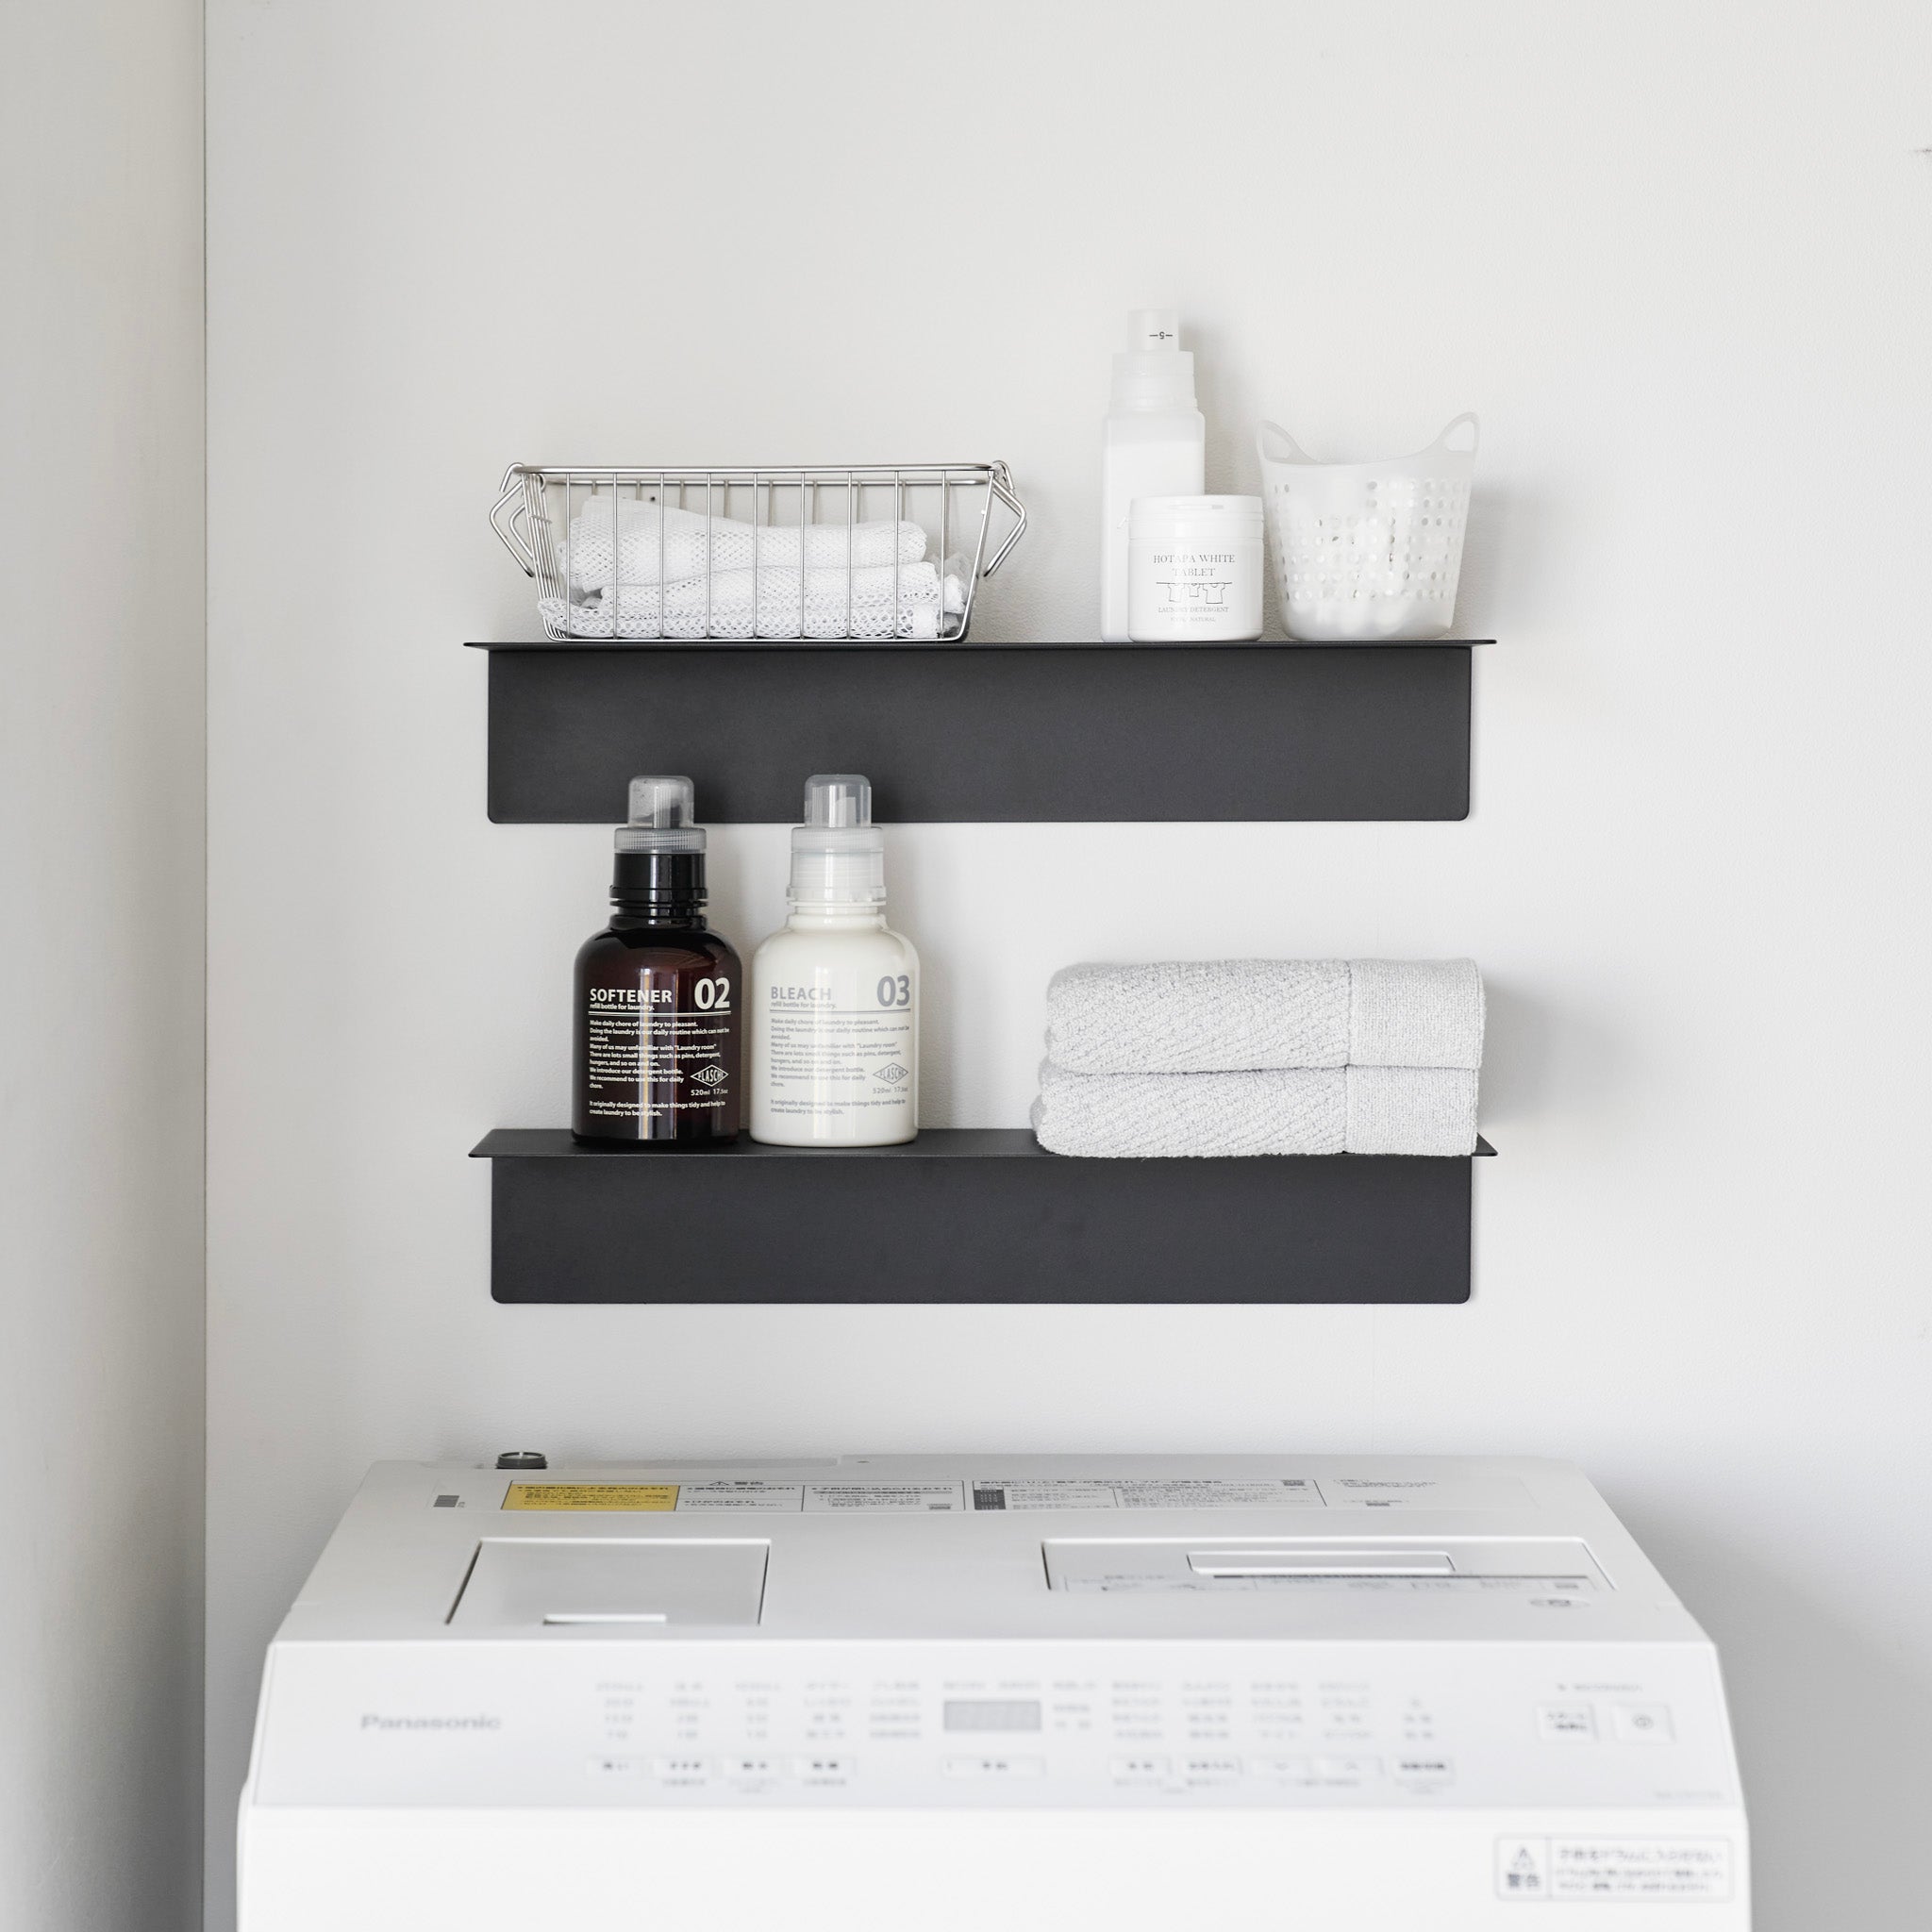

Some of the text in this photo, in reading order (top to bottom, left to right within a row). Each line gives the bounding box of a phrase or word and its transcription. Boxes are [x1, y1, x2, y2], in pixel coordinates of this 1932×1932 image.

[1154, 554, 1235, 564] HOTAPA WHITE
[1172, 568, 1216, 576] TABLET
[590, 988, 673, 1003] SOFTENER
[694, 977, 730, 1009] 02
[770, 986, 832, 1001] BLEACH
[876, 974, 910, 1008] 03
[810, 1002, 838, 1010] laundry.
[359, 1711, 502, 1731] Panasonic
